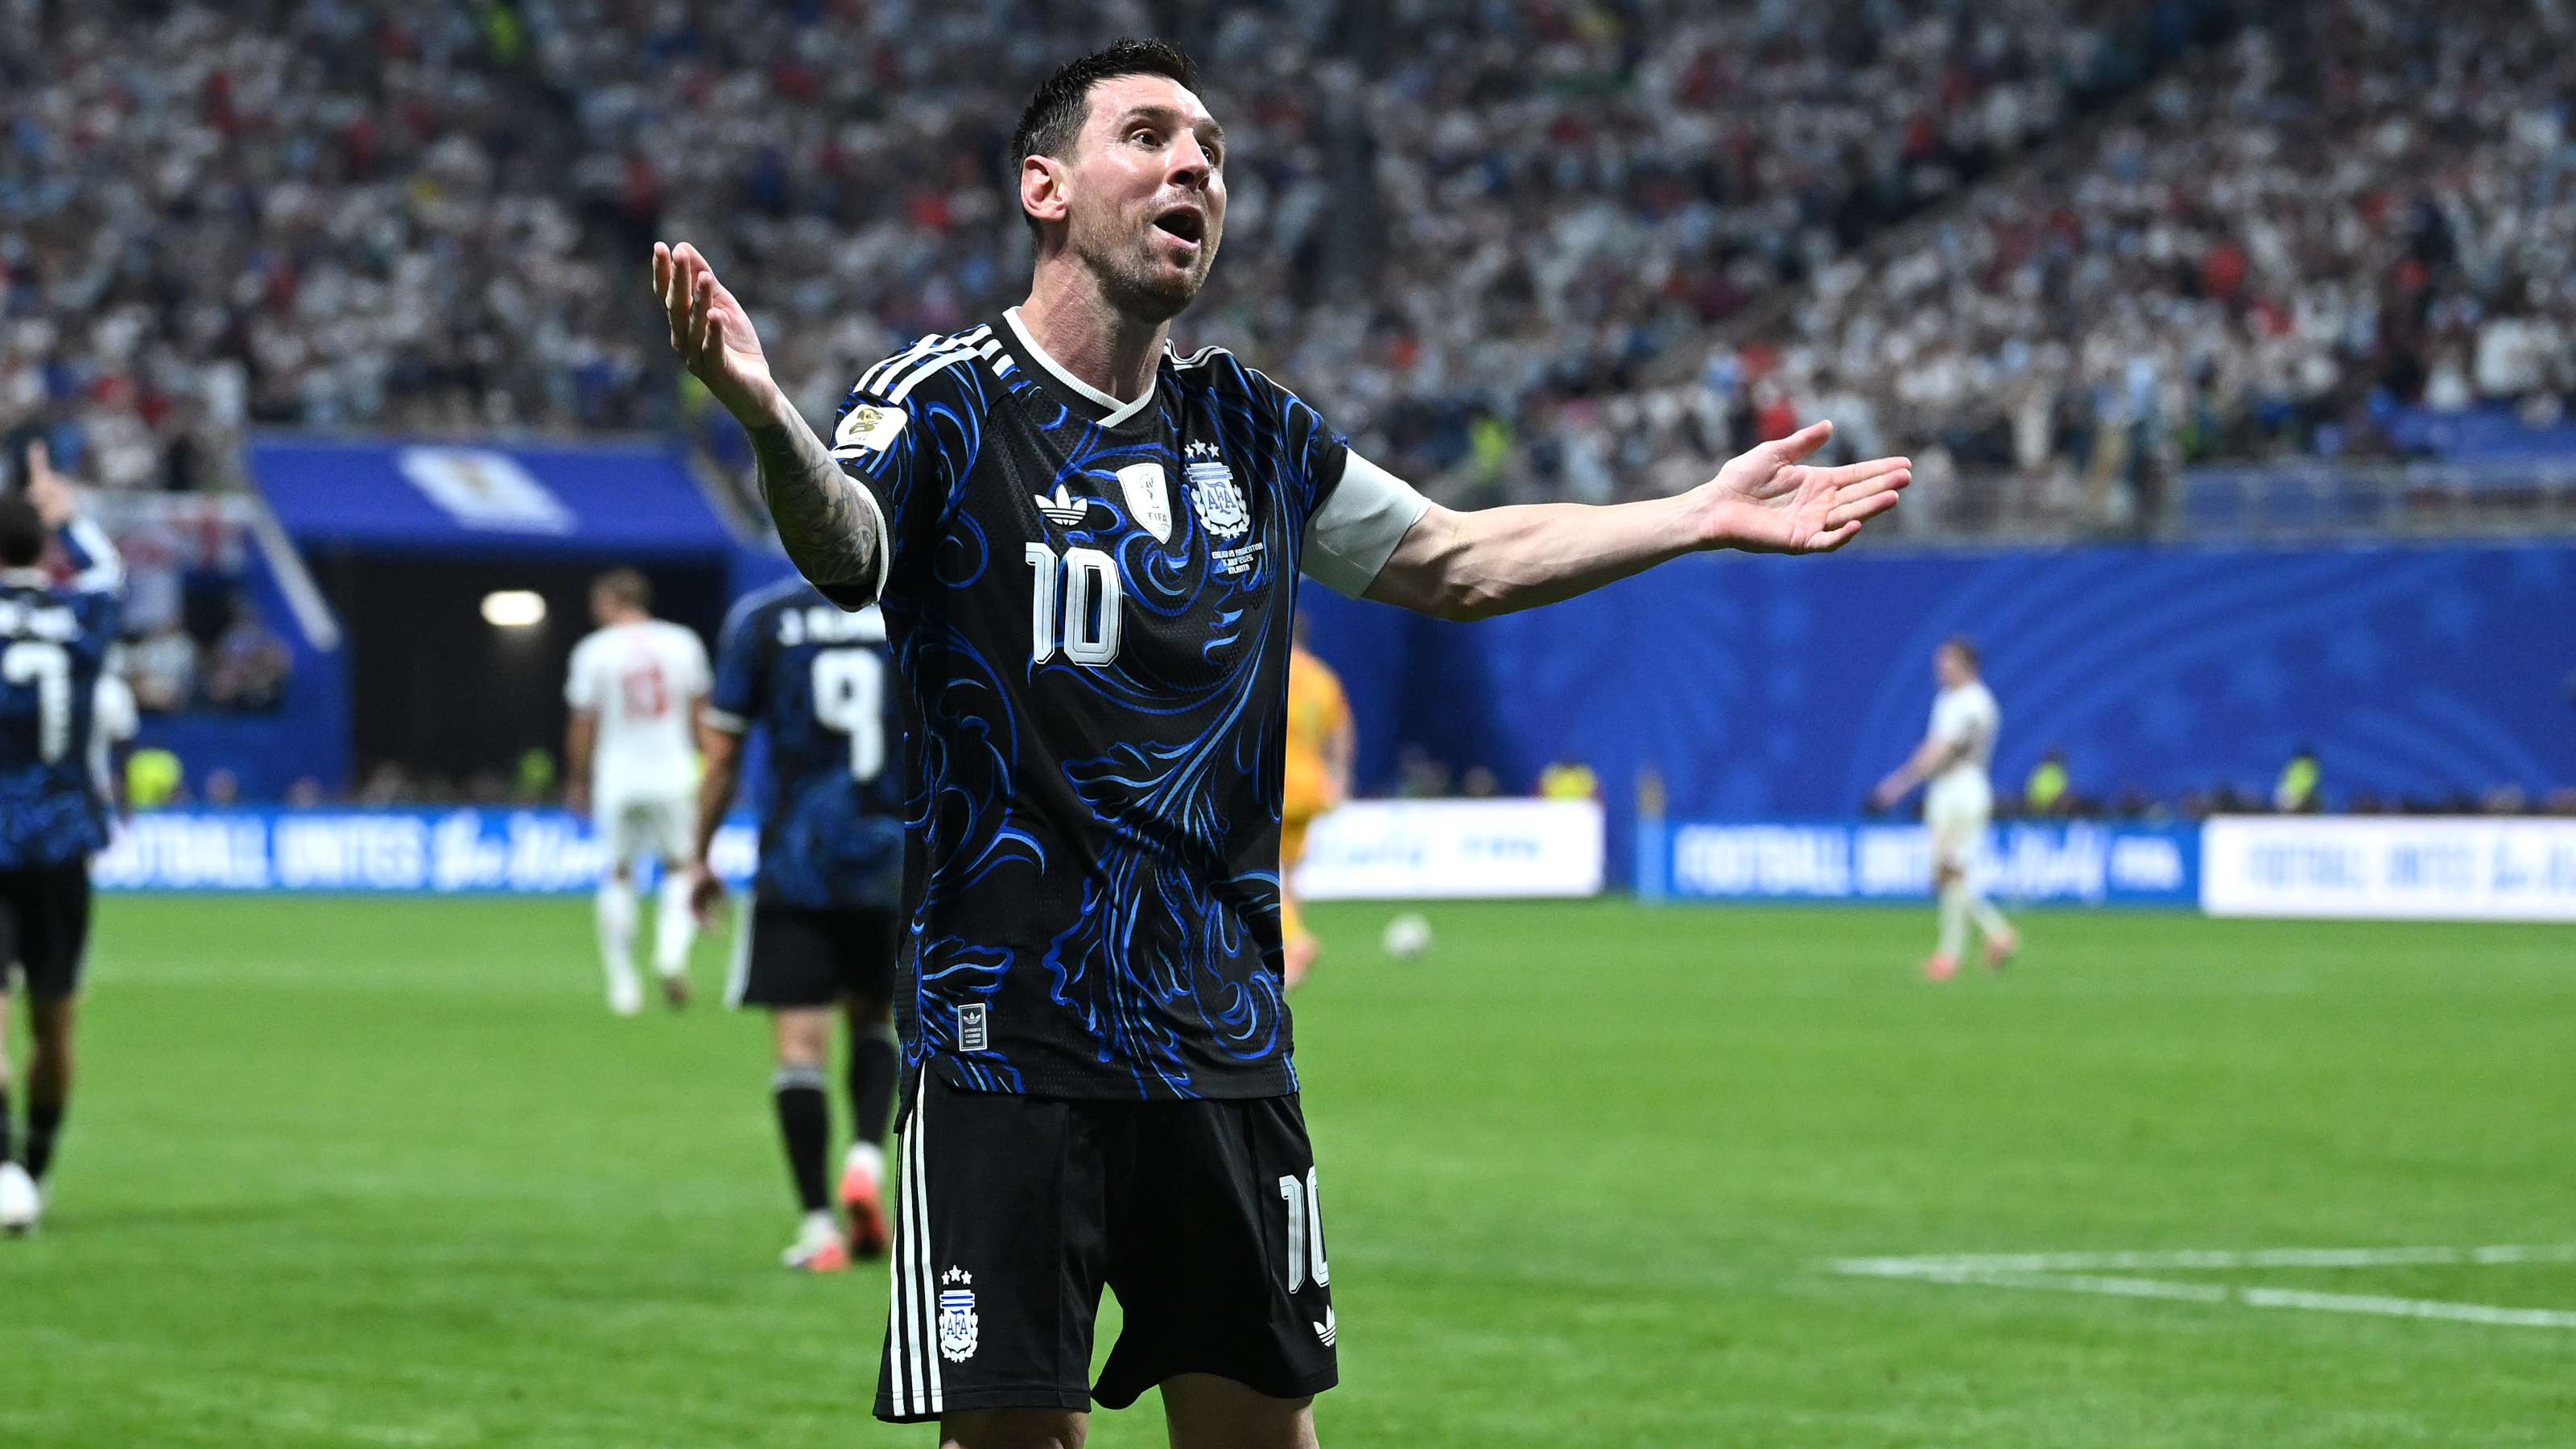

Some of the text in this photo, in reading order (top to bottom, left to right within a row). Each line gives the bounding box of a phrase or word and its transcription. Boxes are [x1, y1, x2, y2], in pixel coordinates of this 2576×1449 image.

[1149, 511, 1168, 522] FIFA
[1205, 481, 1237, 514] AFA
[1238, 554, 1254, 564] 2026
[1026, 542, 1122, 667] 10
[1, 642, 73, 765] 7
[810, 646, 886, 782] 9
[1279, 1166, 1329, 1294] 10
[946, 1309, 968, 1340] AFA
